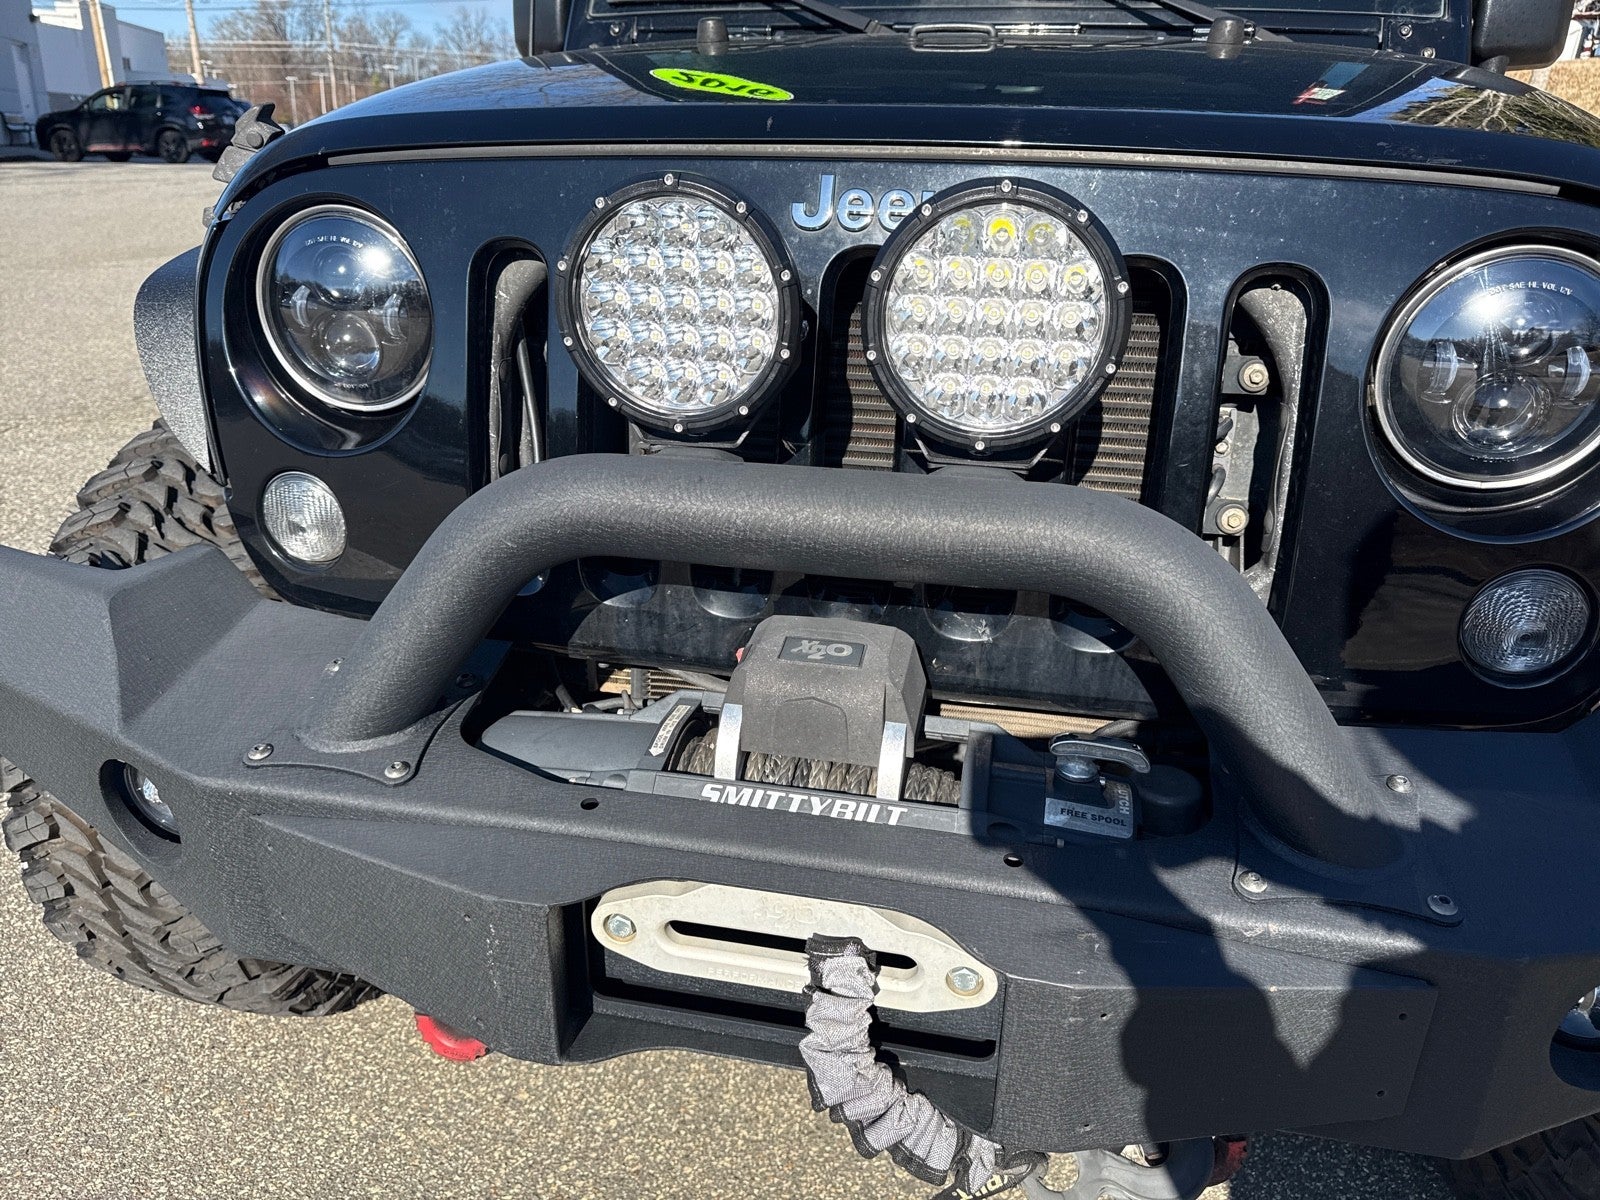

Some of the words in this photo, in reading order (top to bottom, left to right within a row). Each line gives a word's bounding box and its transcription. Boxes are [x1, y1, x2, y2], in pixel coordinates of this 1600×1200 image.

[791, 174, 936, 233] Jee
[1509, 281, 1526, 290] SAE
[1542, 281, 1557, 292] VOL
[700, 784, 908, 826] SMITTYBILT
[1060, 807, 1088, 820] FREE
[1091, 813, 1127, 827] SPOOL
